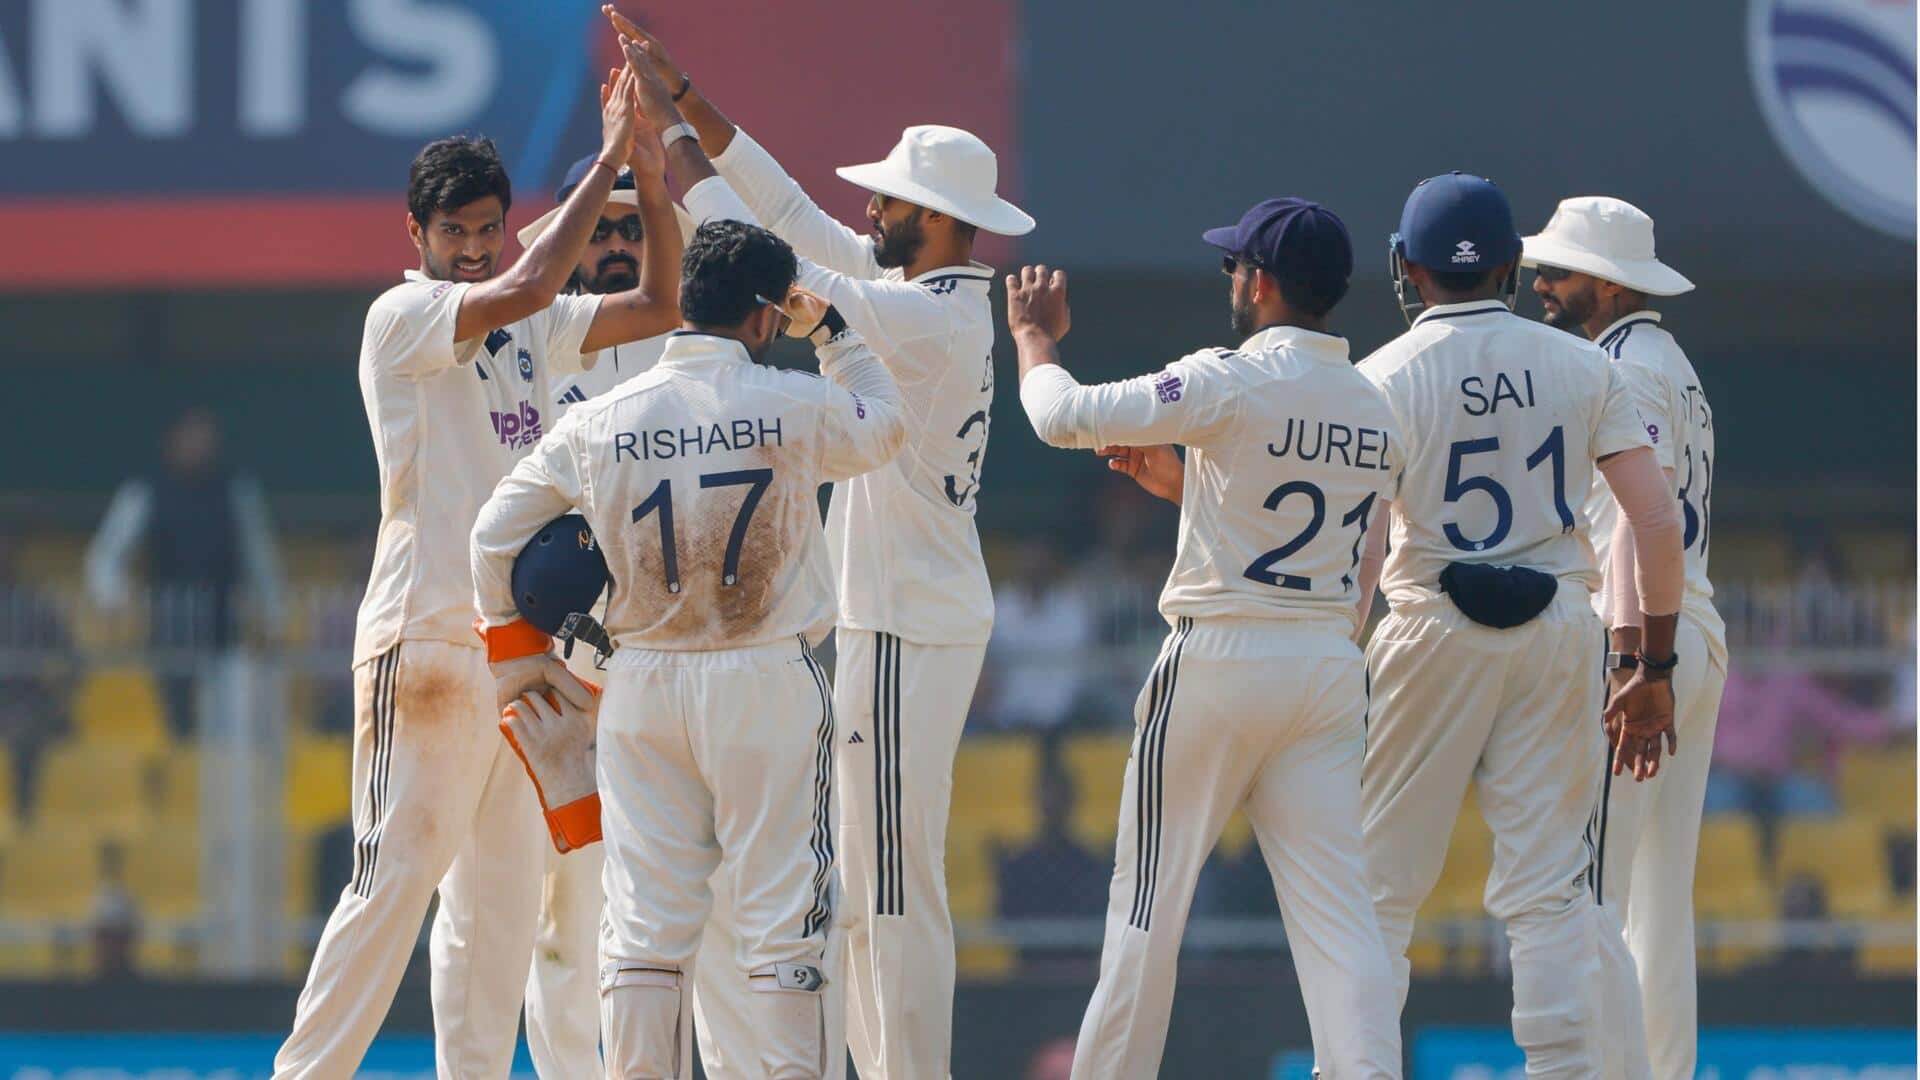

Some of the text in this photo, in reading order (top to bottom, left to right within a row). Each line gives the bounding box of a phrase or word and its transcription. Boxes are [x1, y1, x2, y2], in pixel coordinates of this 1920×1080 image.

[1461, 369, 1536, 417] SAI
[615, 417, 783, 463] RISHABH
[1267, 418, 1391, 471] JUREL
[1442, 425, 1576, 552] 51
[631, 468, 774, 594] 17
[1242, 480, 1378, 593] 21
